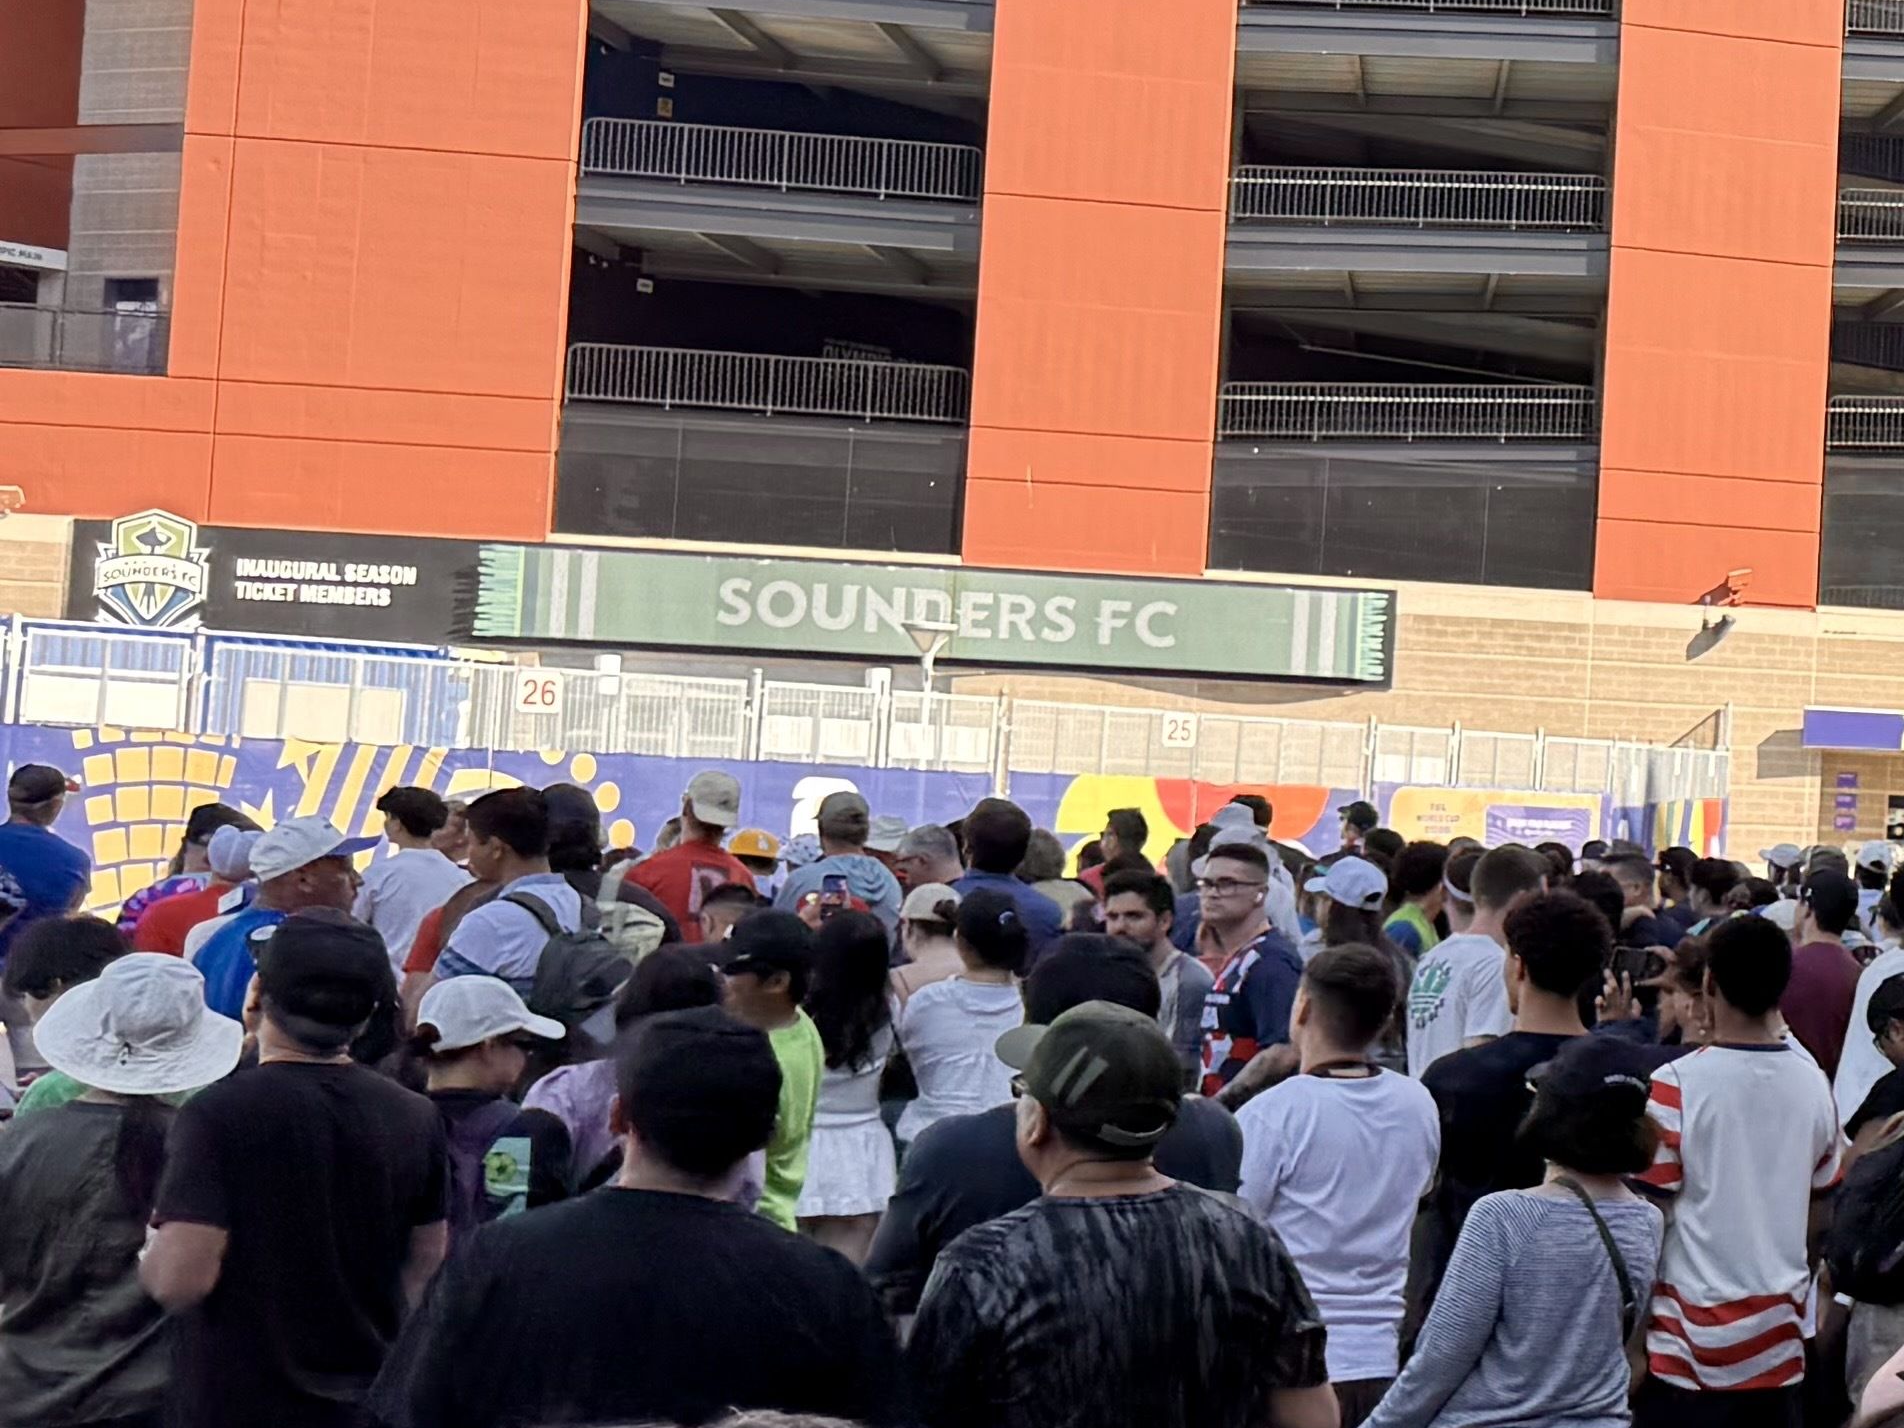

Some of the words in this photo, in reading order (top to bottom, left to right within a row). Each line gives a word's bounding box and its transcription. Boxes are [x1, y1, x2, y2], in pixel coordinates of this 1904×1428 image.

[236, 557, 340, 581] INAUGURAL
[344, 563, 417, 585] SEASON
[235, 581, 297, 601] TICKET
[300, 585, 391, 606] MEMBERS
[716, 578, 1076, 643] SOUNDERS
[1094, 599, 1179, 648] FC
[523, 679, 556, 706] 26
[1168, 719, 1192, 741] 25
